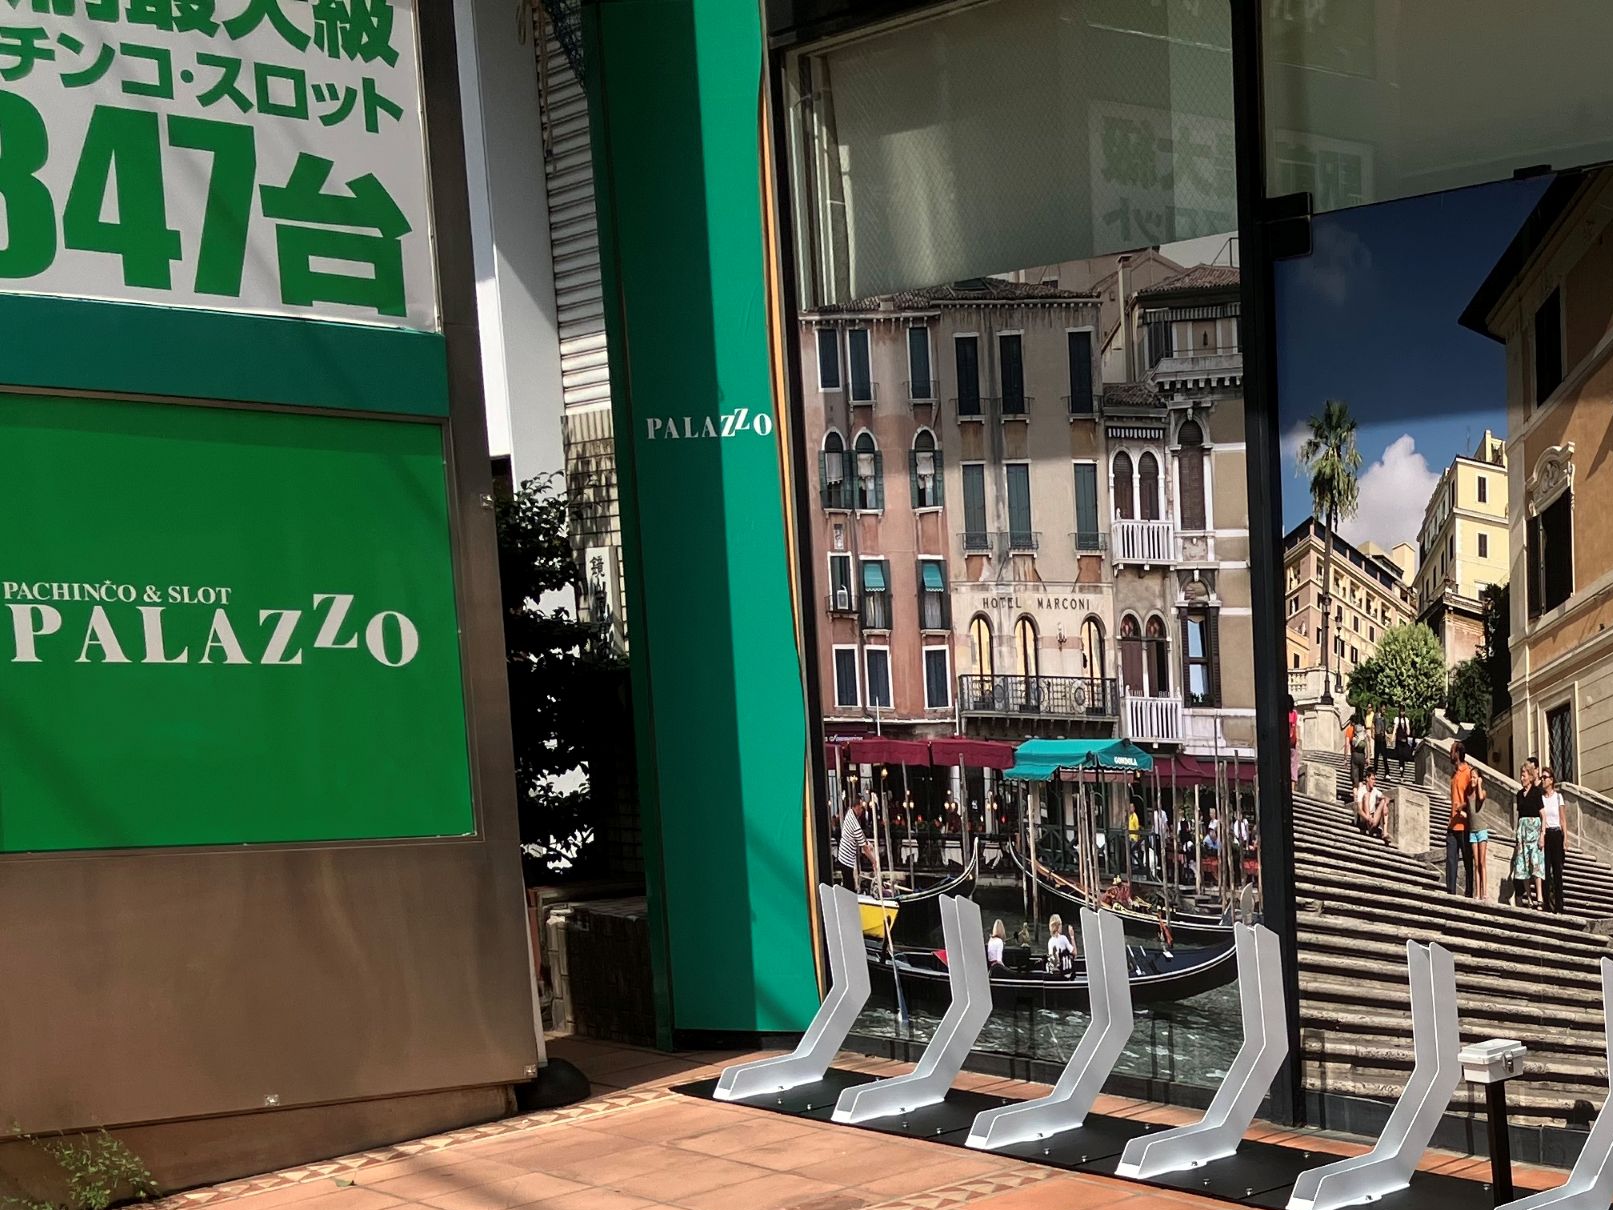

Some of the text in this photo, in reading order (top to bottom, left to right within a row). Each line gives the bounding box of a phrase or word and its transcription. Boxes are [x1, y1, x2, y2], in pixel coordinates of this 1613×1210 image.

[646, 408, 773, 439] PALAZZO
[3, 580, 232, 605] PACHINCO & SLOT
[982, 597, 1091, 611] HOTEL MARCONI
[4, 593, 419, 667] PALAZZO
